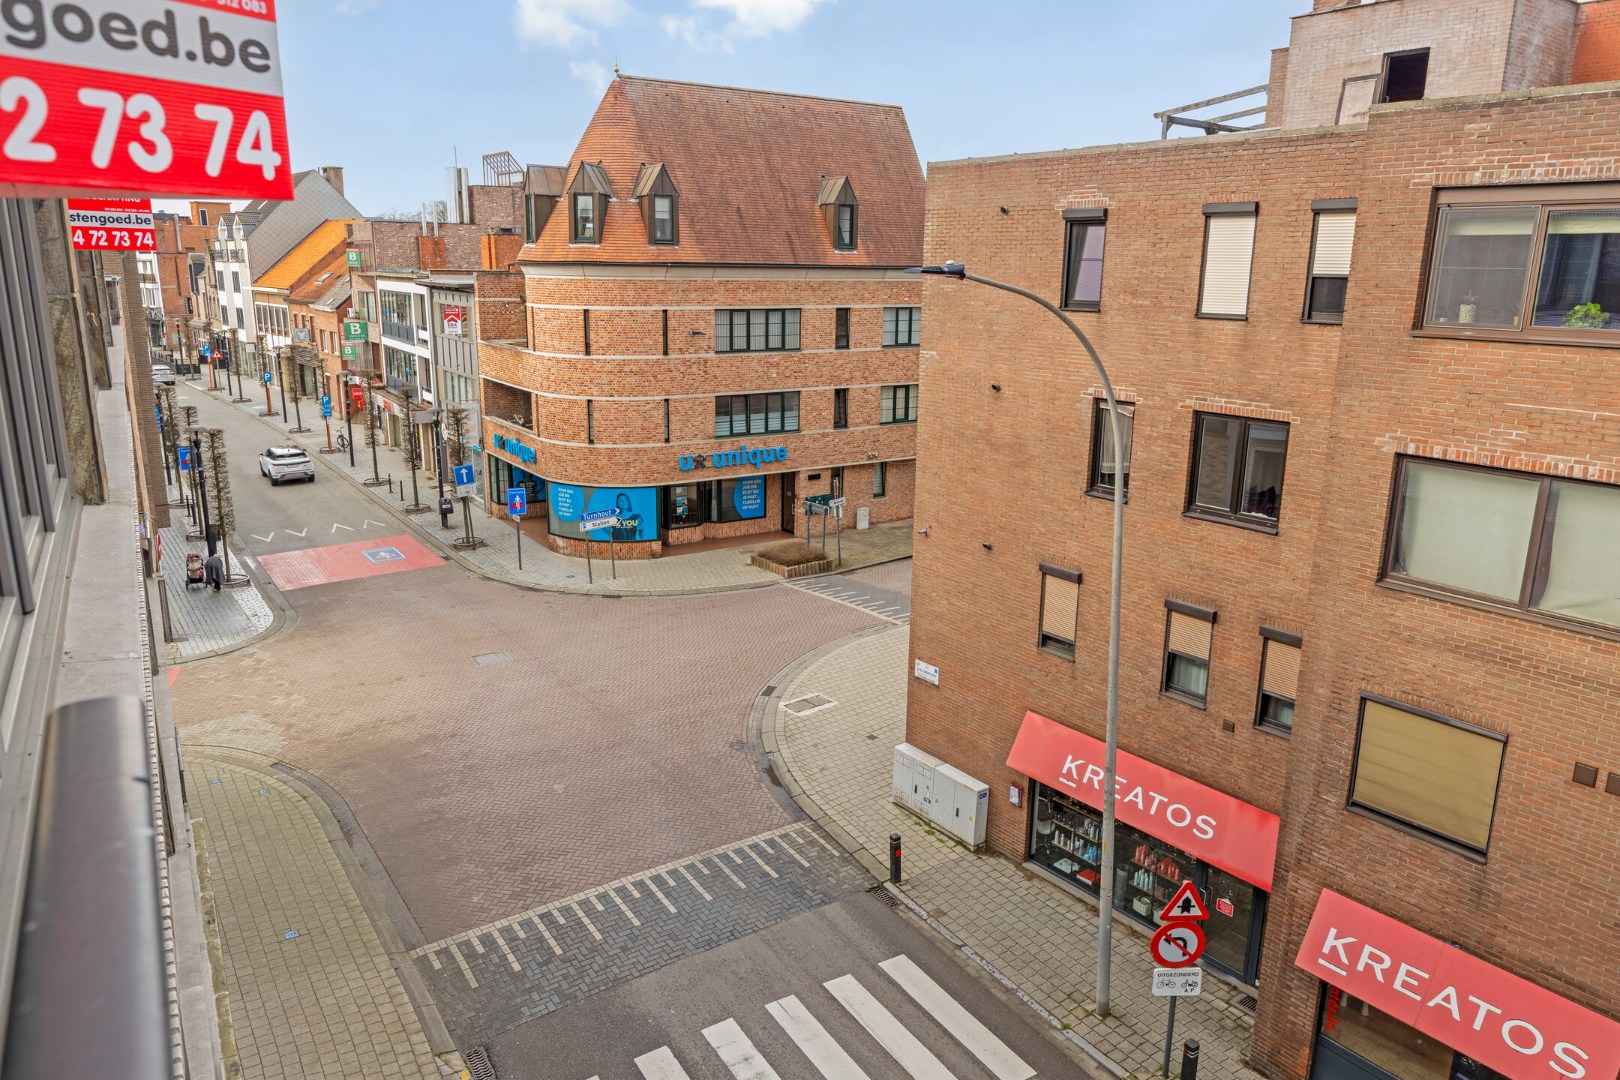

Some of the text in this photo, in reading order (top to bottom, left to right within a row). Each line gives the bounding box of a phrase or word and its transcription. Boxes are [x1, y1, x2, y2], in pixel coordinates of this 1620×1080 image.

[0, 0, 271, 74] goed.be
[77, 87, 174, 174] 73
[194, 103, 282, 181] 74
[70, 212, 152, 226] stengoed.be
[88, 229, 109, 246] 72
[111, 230, 131, 247] 73
[134, 231, 154, 248] 74
[350, 323, 362, 335] B
[264, 373, 271, 381] P
[323, 396, 329, 404] P
[713, 444, 788, 468] unique
[583, 509, 612, 520] Turnhout
[1060, 754, 1217, 840] KREATOS
[1320, 927, 1589, 1079] KREATOS
